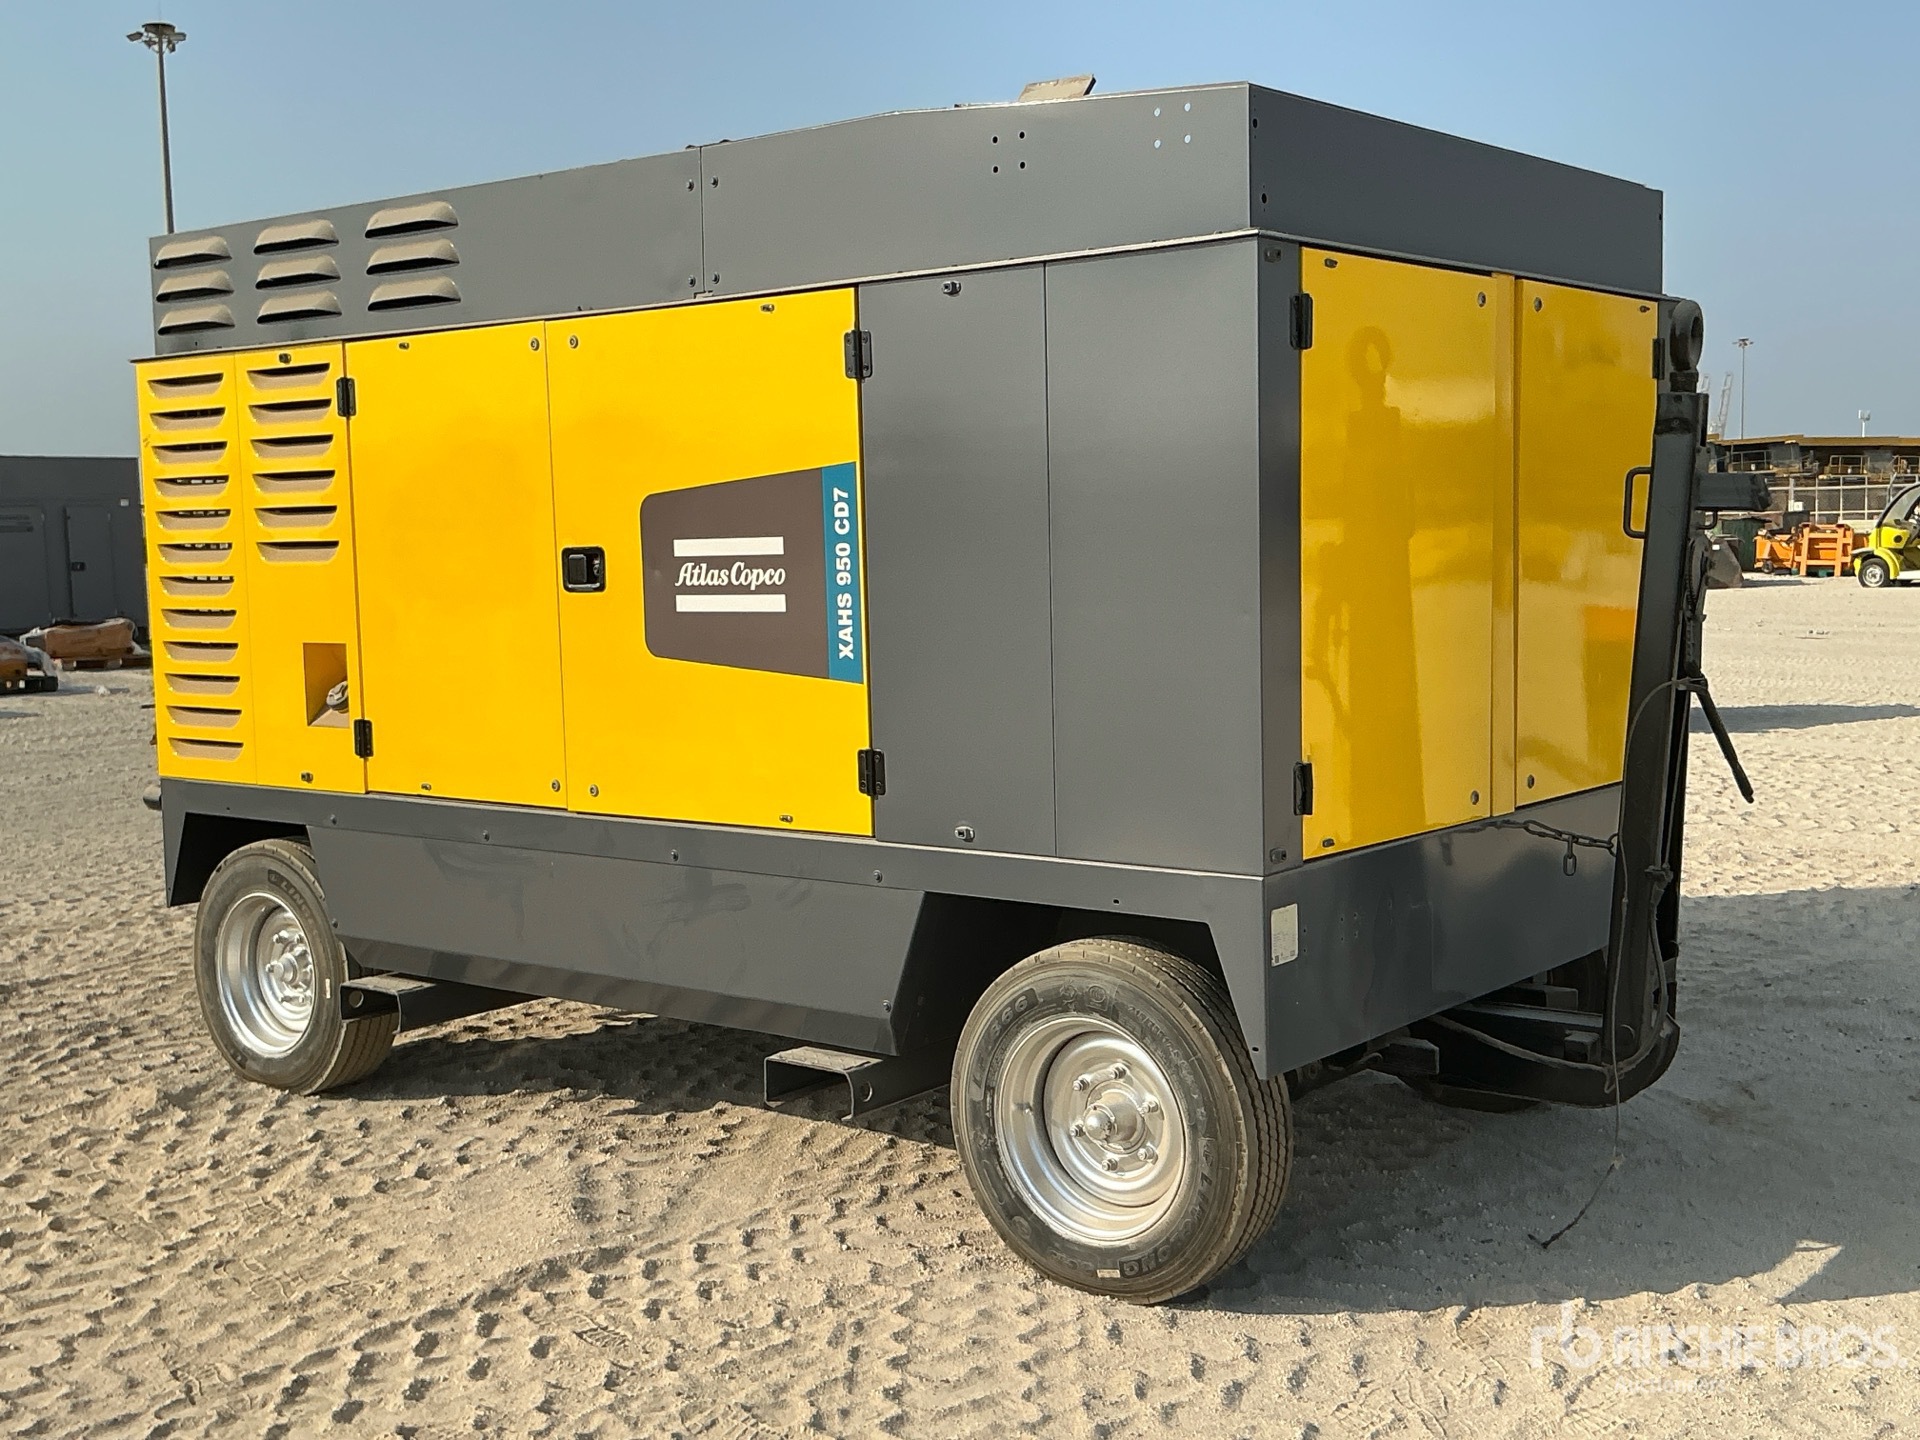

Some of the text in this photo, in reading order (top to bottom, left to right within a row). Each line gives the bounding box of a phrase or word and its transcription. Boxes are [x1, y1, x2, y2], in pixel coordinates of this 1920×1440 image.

[674, 561, 786, 591] Atlas Copco
[833, 487, 854, 660] XAHS 950 CD7
